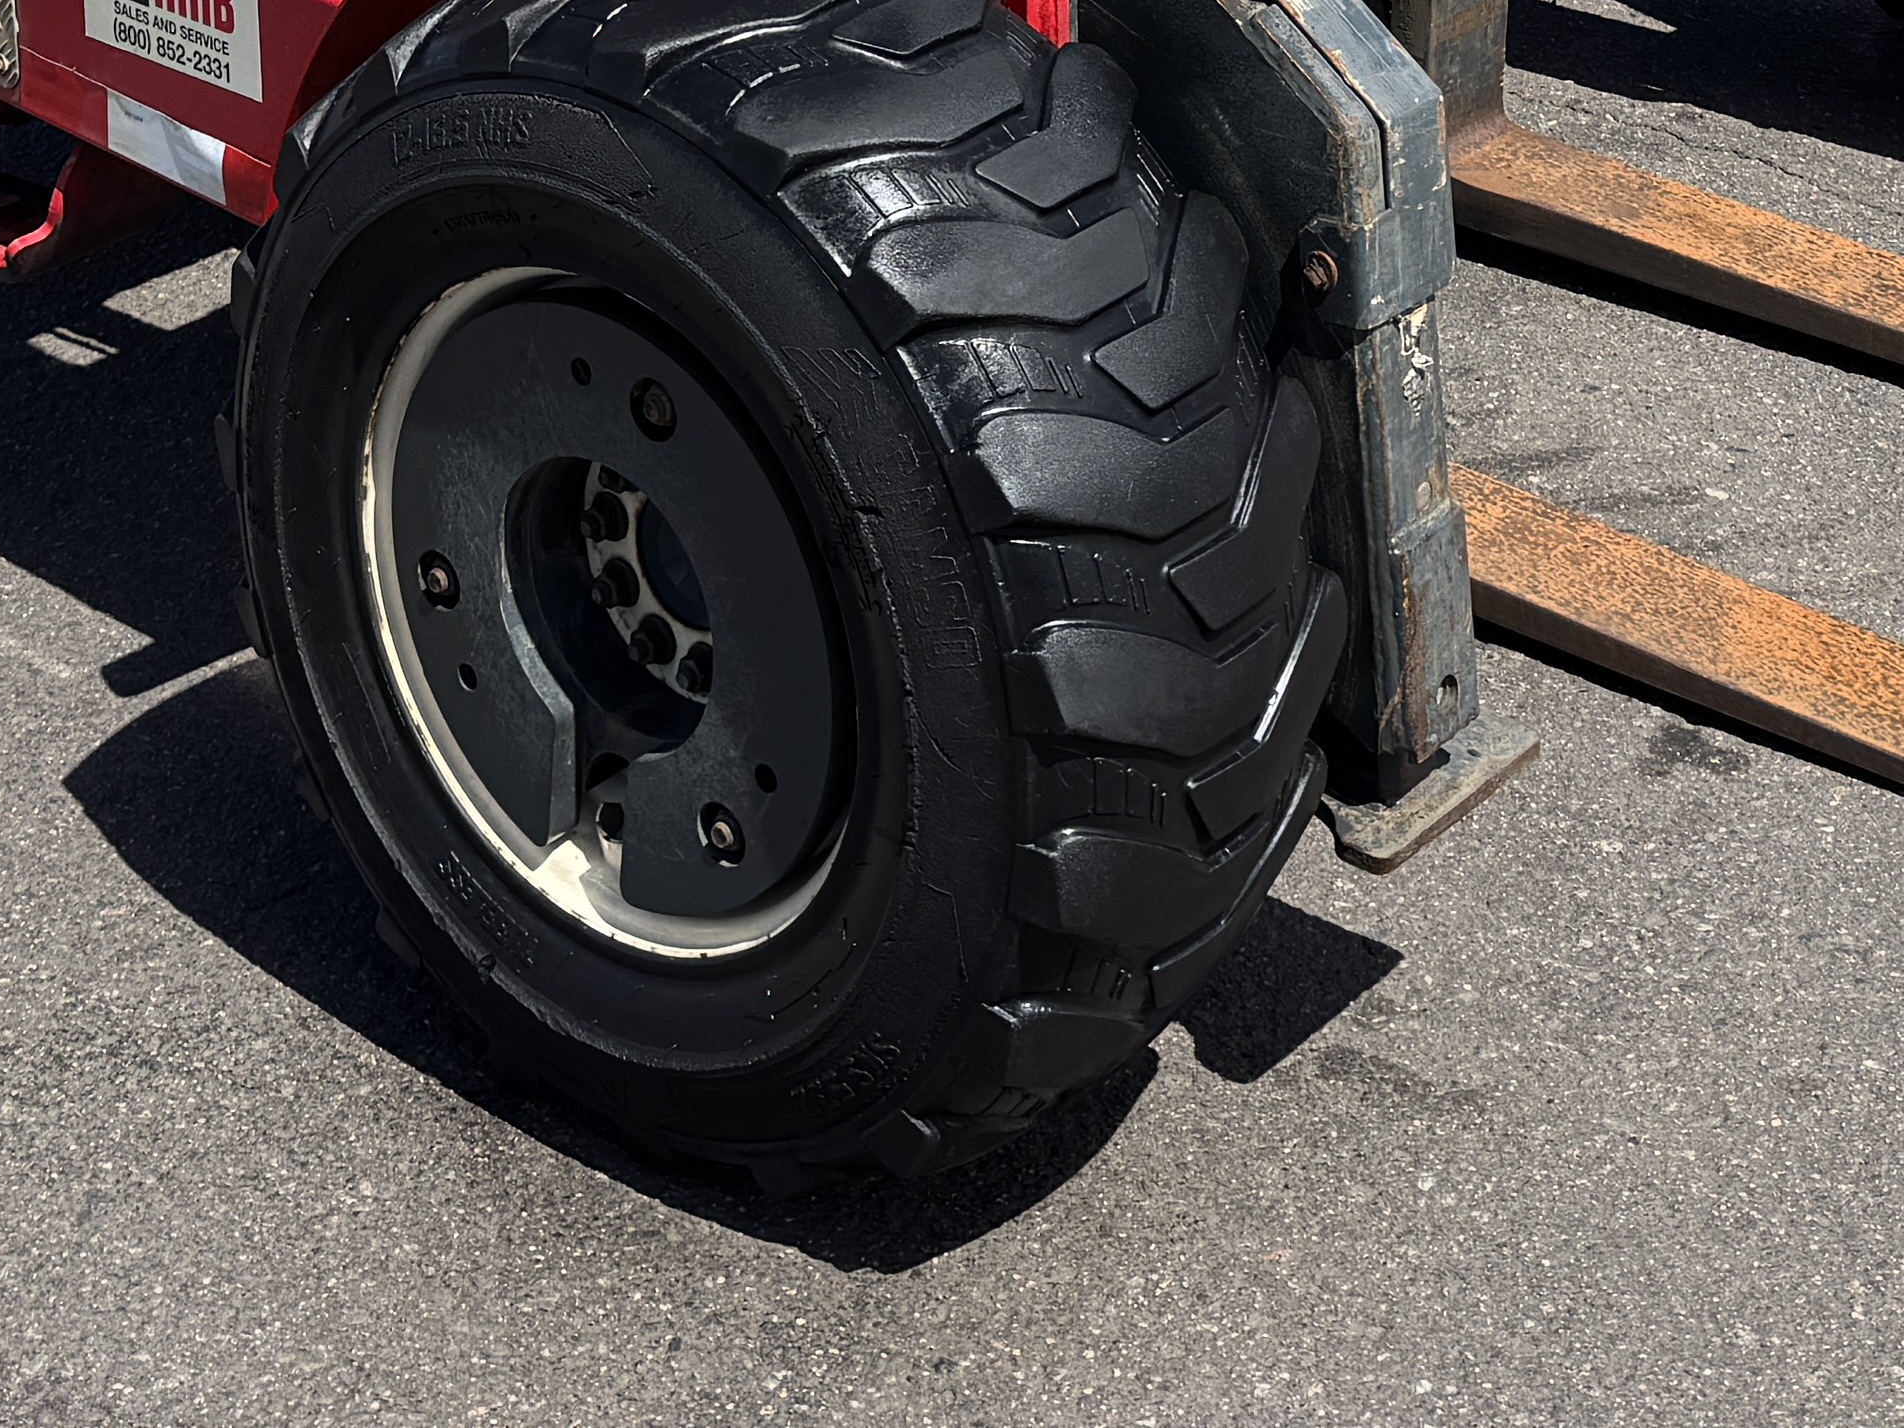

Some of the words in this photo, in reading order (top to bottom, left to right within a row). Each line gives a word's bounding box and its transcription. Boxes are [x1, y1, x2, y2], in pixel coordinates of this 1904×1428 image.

[113, 17, 152, 55] (800)
[156, 36, 231, 84] 852-2331
[114, 0, 150, 26] SALES
[152, 15, 177, 36] AND
[180, 25, 230, 56] SERVICE
